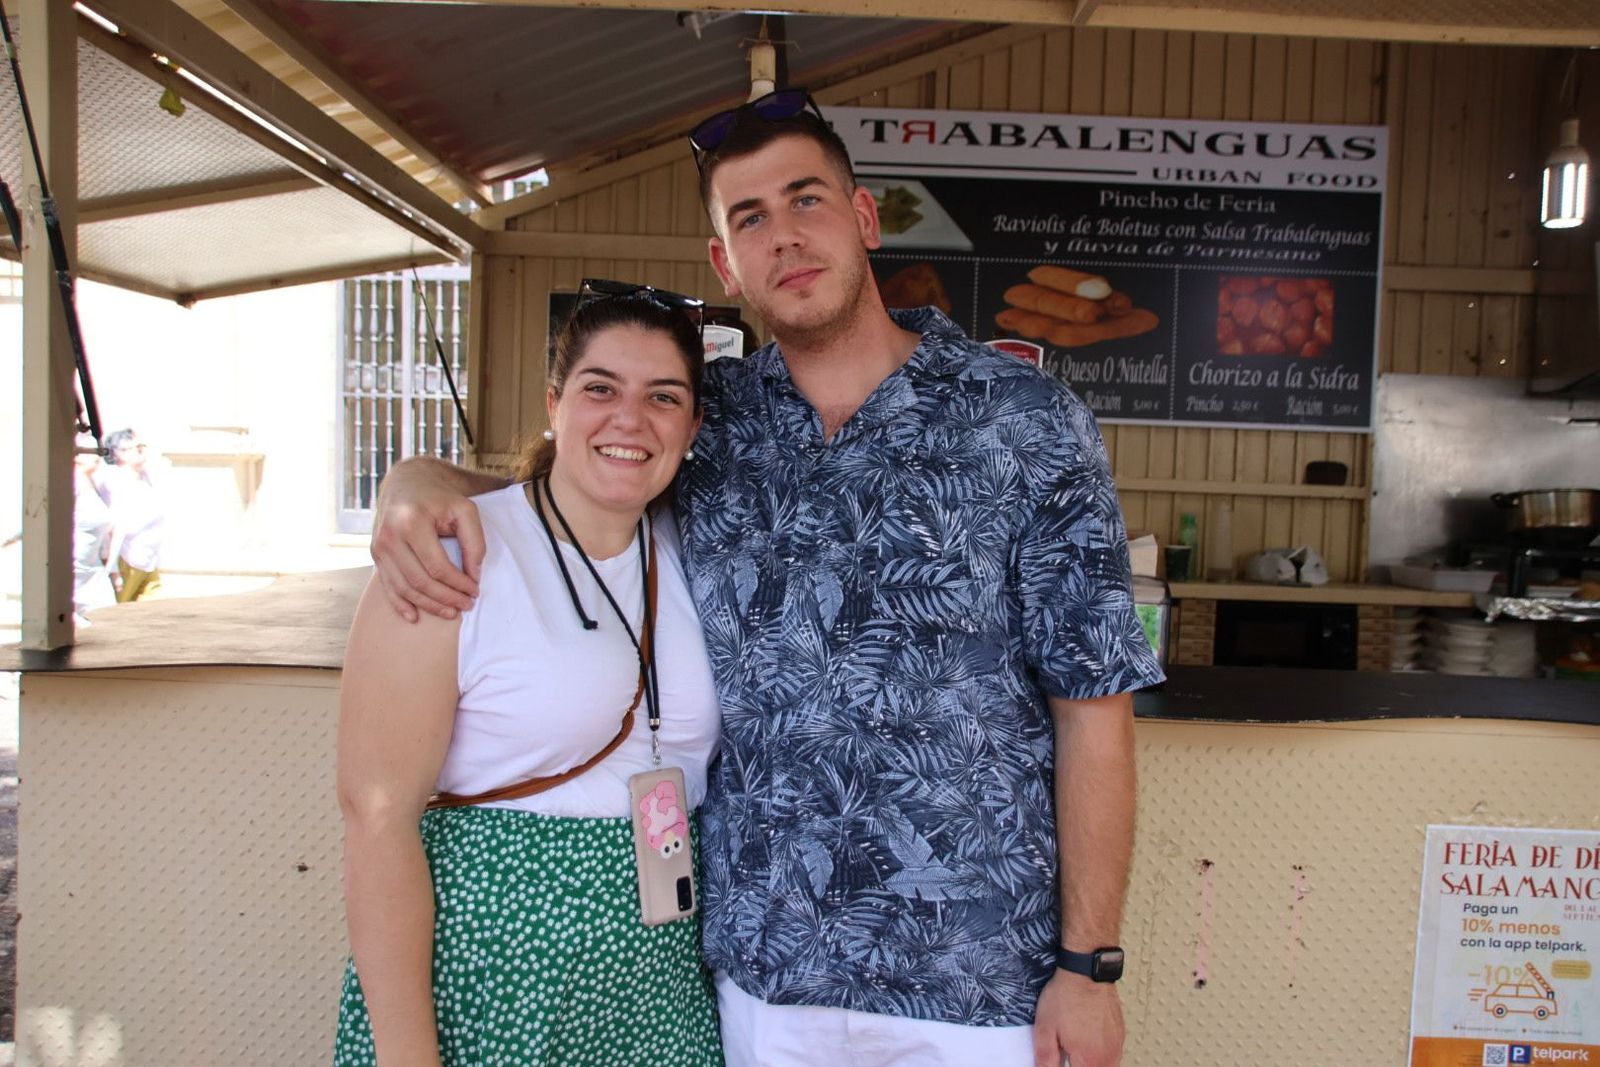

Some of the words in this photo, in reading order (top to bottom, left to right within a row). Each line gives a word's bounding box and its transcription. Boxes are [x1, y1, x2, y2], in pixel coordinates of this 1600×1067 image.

[860, 117, 1377, 161] TRABALENGUAS
[1152, 167, 1263, 184] URBAN
[1287, 171, 1379, 189] FOOD
[1099, 189, 1178, 209] Pincho
[1184, 193, 1212, 211] de
[1219, 195, 1276, 214] Feria
[993, 214, 1066, 235] Raviolis
[1071, 215, 1092, 236] de
[1097, 217, 1162, 239] Boletus
[1165, 223, 1196, 240] con
[1201, 220, 1246, 242] Salsa
[1252, 223, 1372, 250] Trabalenguas
[1044, 240, 1059, 256] y
[1067, 238, 1139, 255] lluvia
[1147, 241, 1176, 257] de
[1184, 244, 1321, 262] Parmesano
[1061, 354, 1100, 387] Queso
[1116, 354, 1168, 385] Nutella
[1188, 359, 1262, 388] Chorizo
[1266, 372, 1279, 388] a
[1284, 362, 1303, 389] la
[1308, 364, 1360, 391] Sidra
[1186, 393, 1224, 414] Pincho
[1530, 845, 1563, 868] DE
[1463, 903, 1498, 916] Paga
[1501, 906, 1518, 914] un
[1461, 919, 1494, 933] 10%
[1499, 922, 1561, 935] menos
[1460, 938, 1485, 947] con
[1489, 938, 1501, 948] la
[1505, 941, 1531, 951] app
[1535, 940, 1587, 953] telpark.
[1533, 1046, 1589, 1063] telpark
